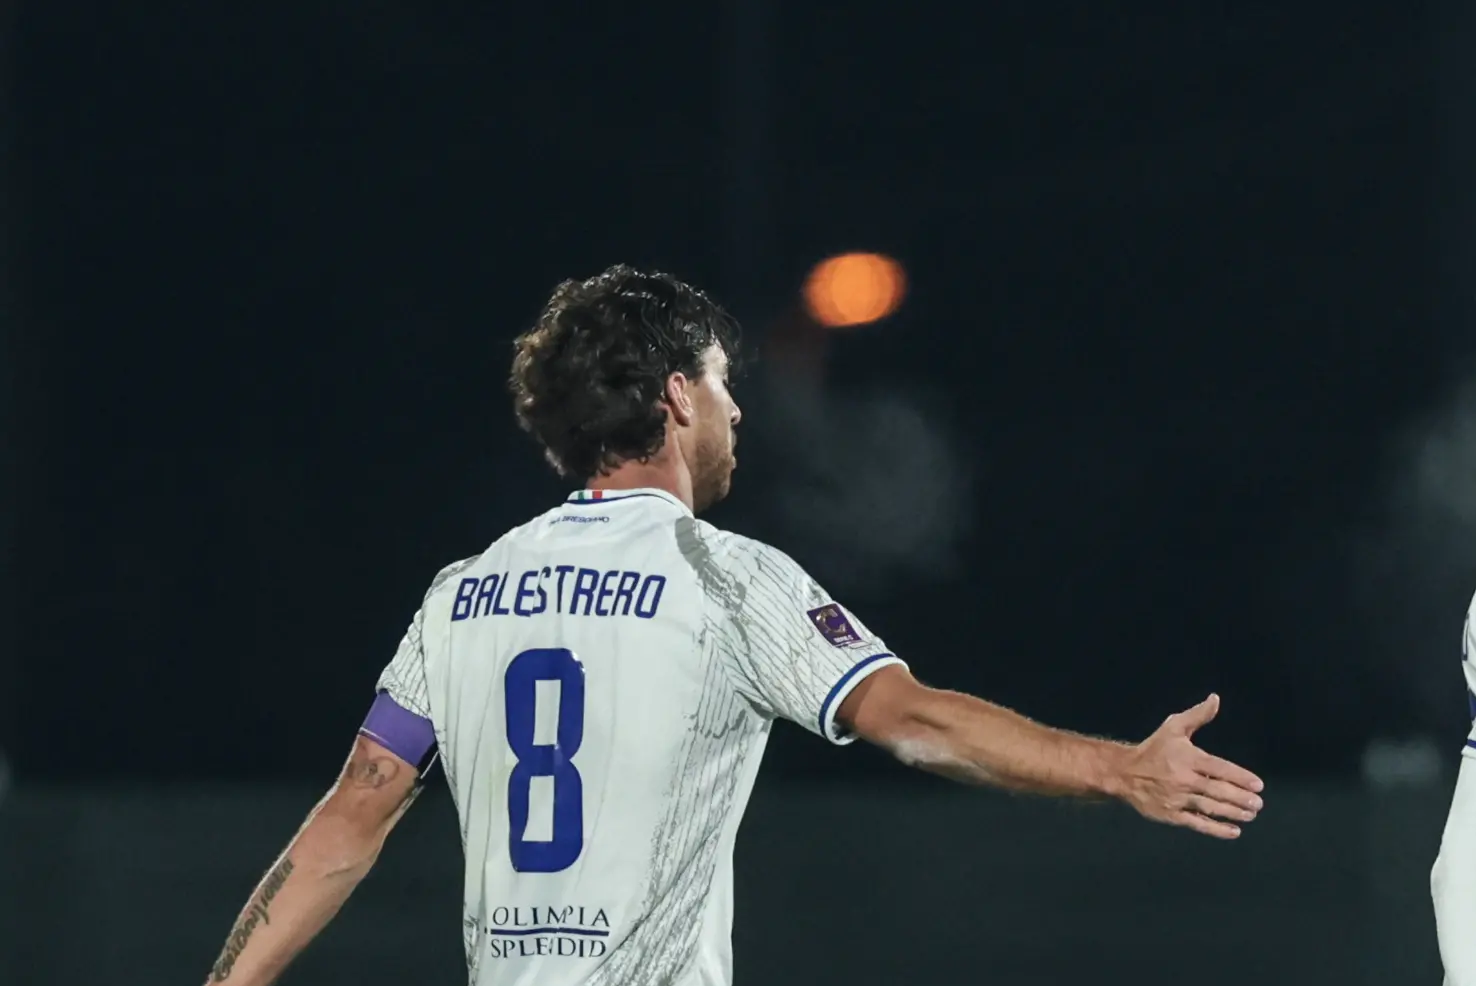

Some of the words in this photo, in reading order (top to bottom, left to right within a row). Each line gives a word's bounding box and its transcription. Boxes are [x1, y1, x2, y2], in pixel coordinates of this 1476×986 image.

[451, 565, 667, 622] BALESTRERO
[503, 647, 586, 873] 8
[491, 937, 606, 958] SPLEDID
